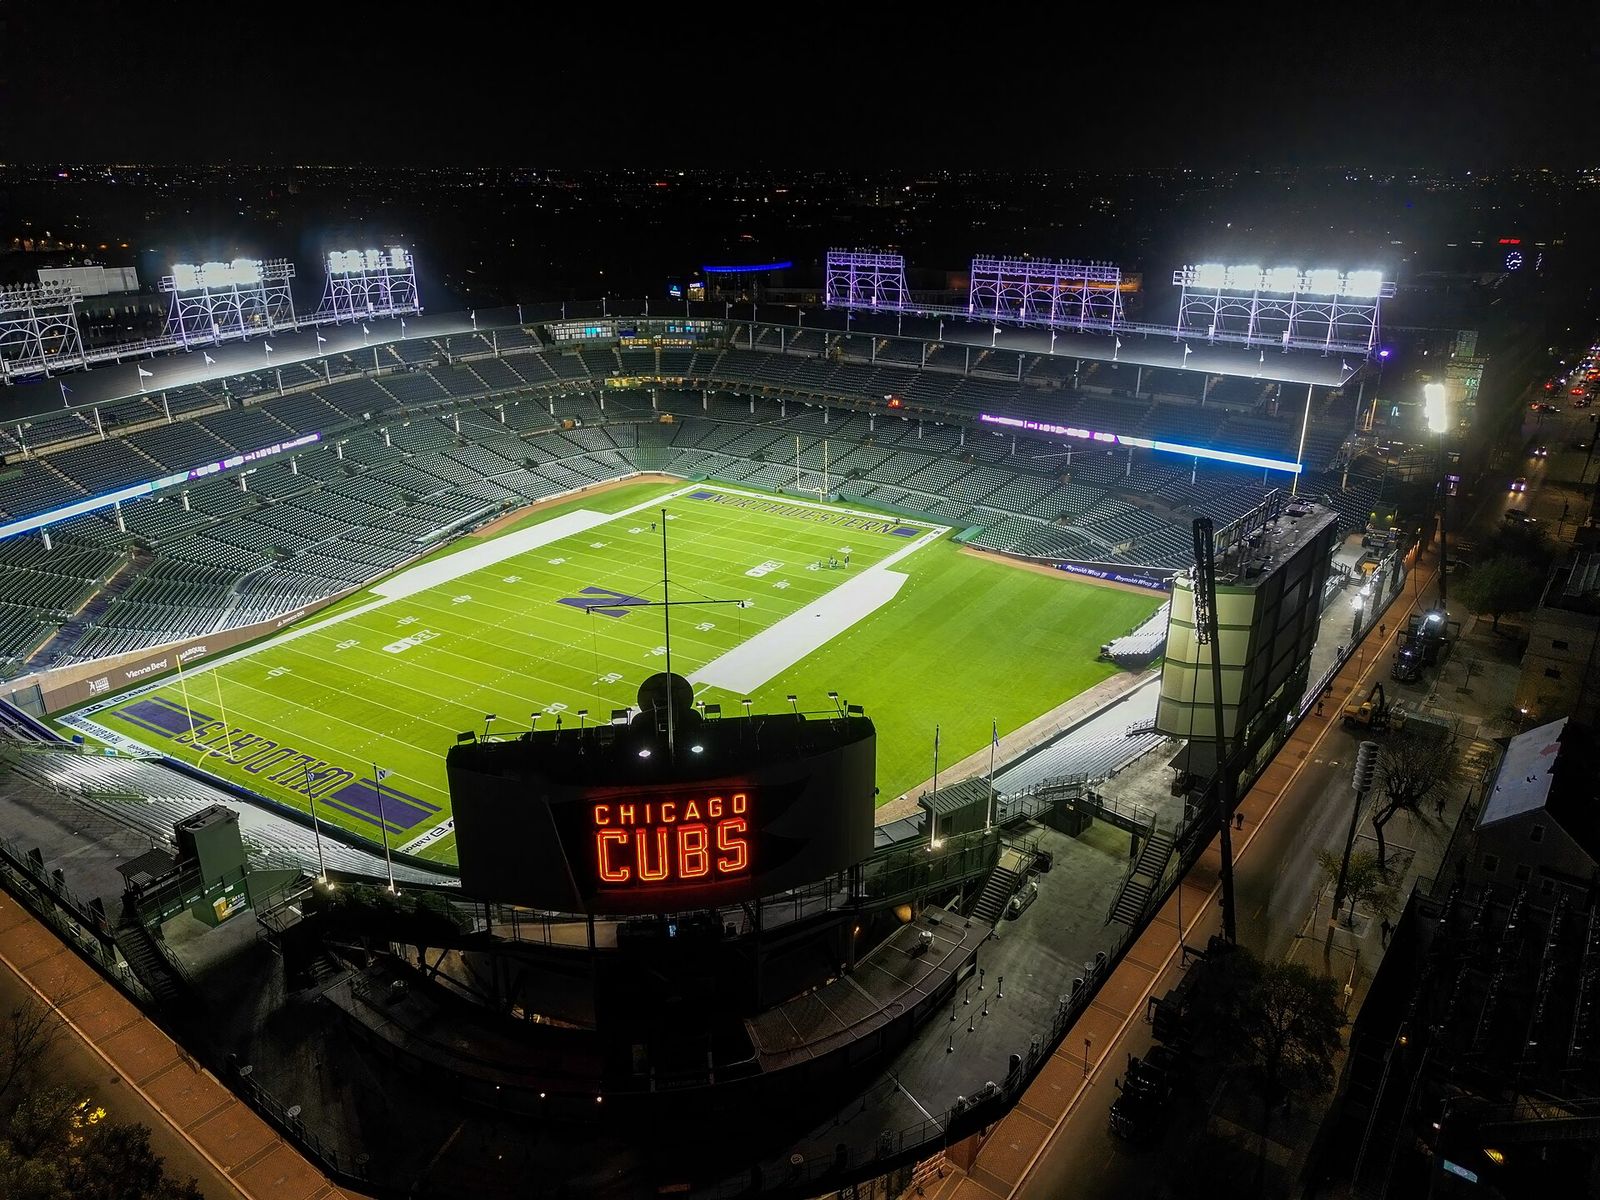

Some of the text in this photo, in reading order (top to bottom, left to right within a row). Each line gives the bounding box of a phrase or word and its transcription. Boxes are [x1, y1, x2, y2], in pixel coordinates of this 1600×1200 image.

[706, 493, 897, 535] NORTHWESTERN
[695, 622, 716, 632] 50
[125, 659, 168, 679] Vienna Beef
[599, 672, 624, 684] 30
[542, 702, 568, 715] 20
[173, 720, 357, 799] WILDCATS
[594, 793, 749, 826] CHICAGO
[597, 817, 747, 882] CUBS
